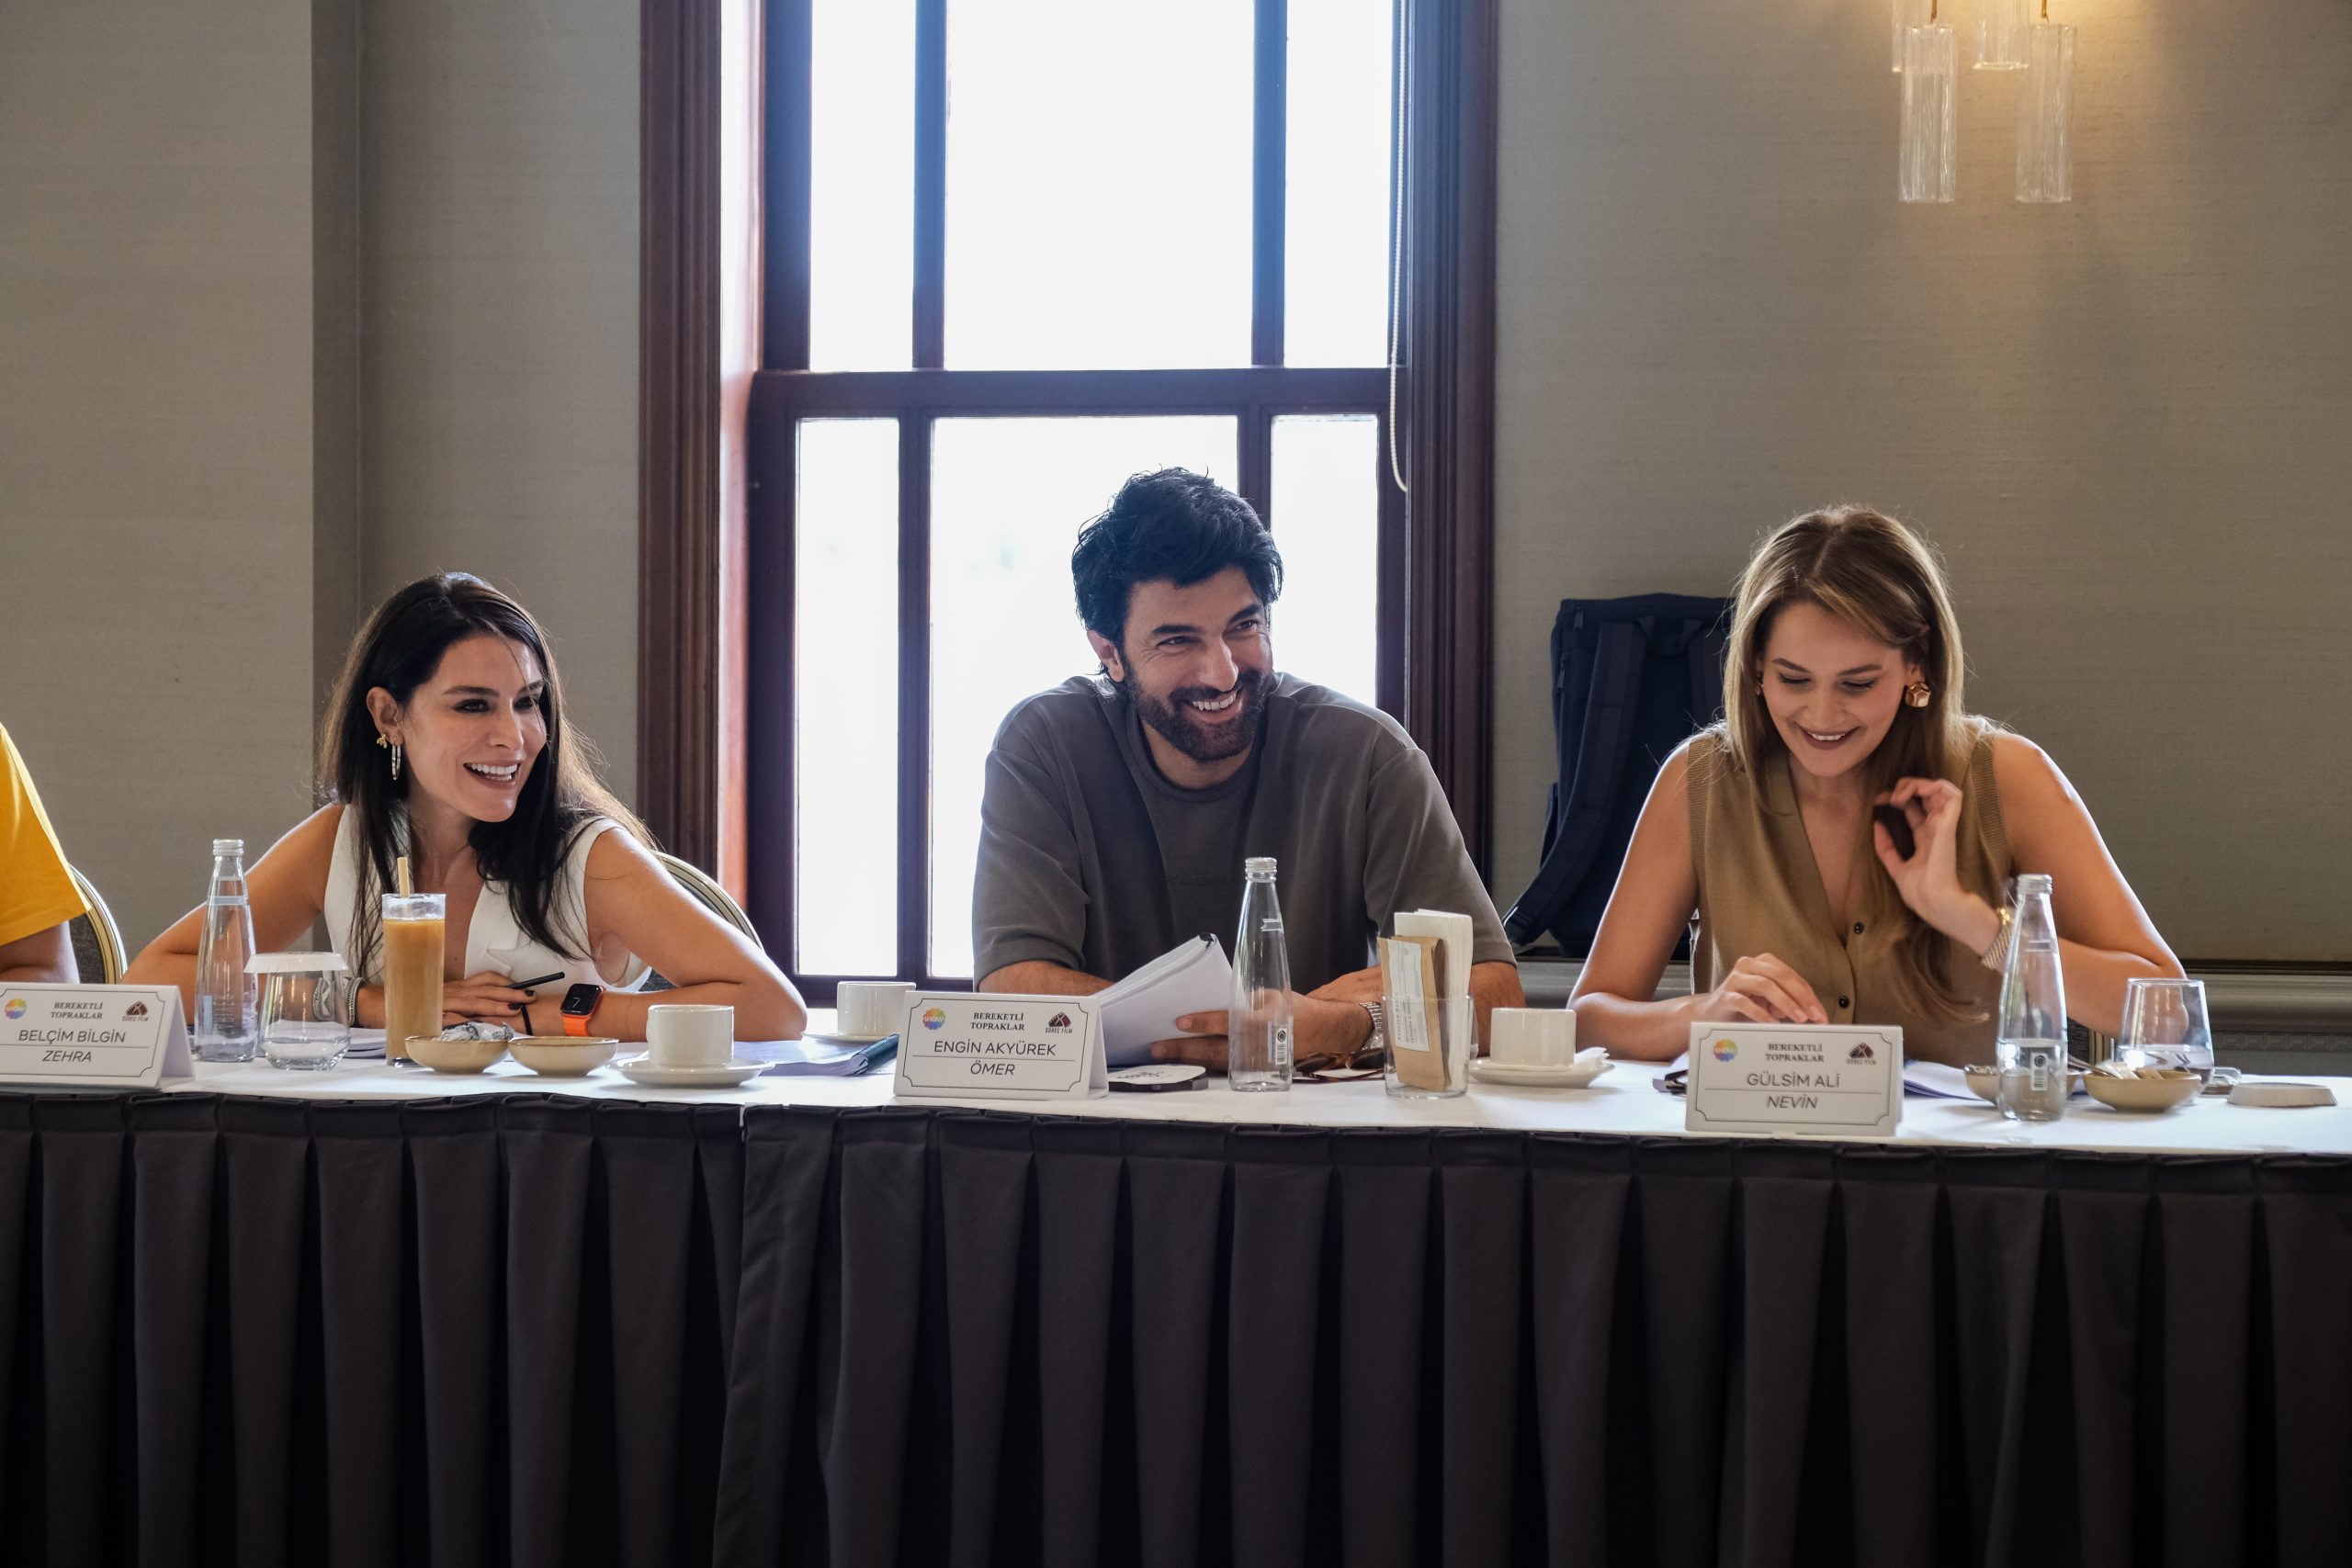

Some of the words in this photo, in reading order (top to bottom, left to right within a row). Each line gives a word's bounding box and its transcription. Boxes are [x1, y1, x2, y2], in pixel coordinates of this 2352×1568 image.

[53, 1002, 103, 1010] BEREKETLİ
[51, 1011, 103, 1020] TOPRAKLAR
[973, 1012, 1024, 1021] BEREKETLİ
[970, 1021, 1025, 1031] TOPRAKLAR
[18, 1028, 74, 1044] BELÇİM
[76, 1029, 126, 1043] BİLGİN
[933, 1039, 981, 1054] ENGİN
[986, 1041, 1057, 1056] AKYÜREK
[1768, 1043, 1823, 1052] BEREKETLİ
[42, 1050, 92, 1062] ZEHRA
[1765, 1054, 1825, 1063] TOPRAKLAR
[970, 1060, 1015, 1076] ÖMER
[1747, 1071, 1810, 1088] GÜLSİM
[1815, 1073, 1840, 1088] ALİ
[1767, 1093, 1819, 1109] NEVİN
